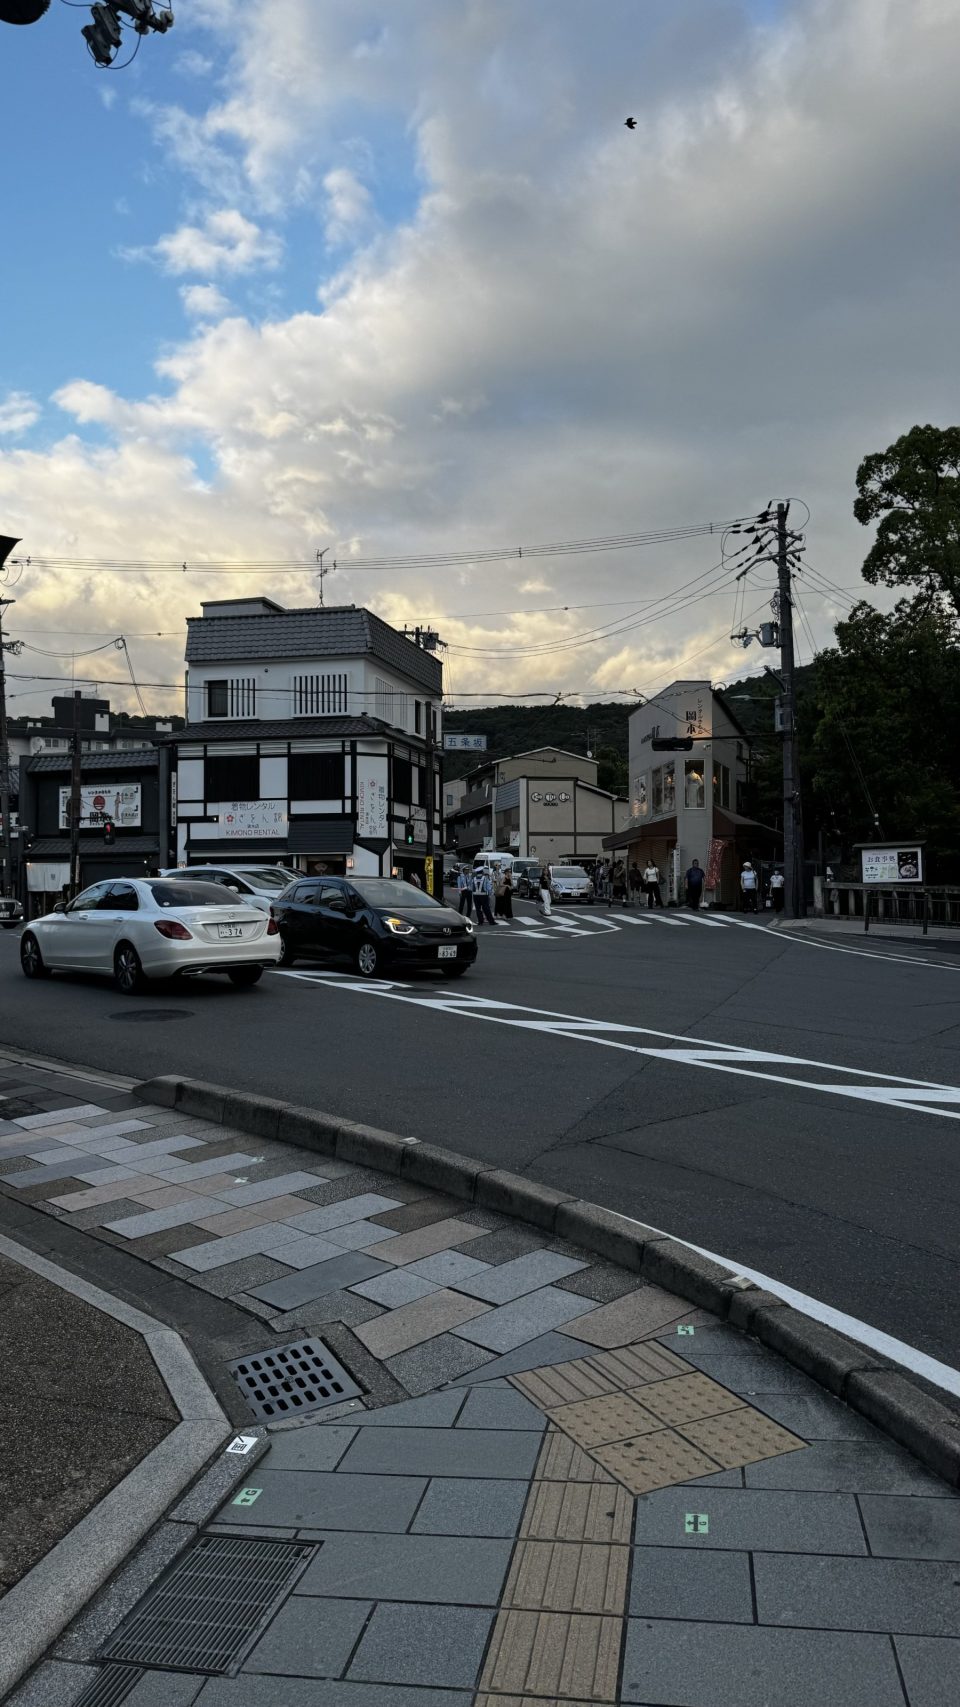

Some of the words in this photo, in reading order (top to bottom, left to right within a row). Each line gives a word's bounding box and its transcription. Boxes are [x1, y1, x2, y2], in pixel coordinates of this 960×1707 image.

[447, 737, 482, 748] 五条坂
[232, 802, 276, 812] 着物レンタル
[867, 855, 896, 863] お食事処
